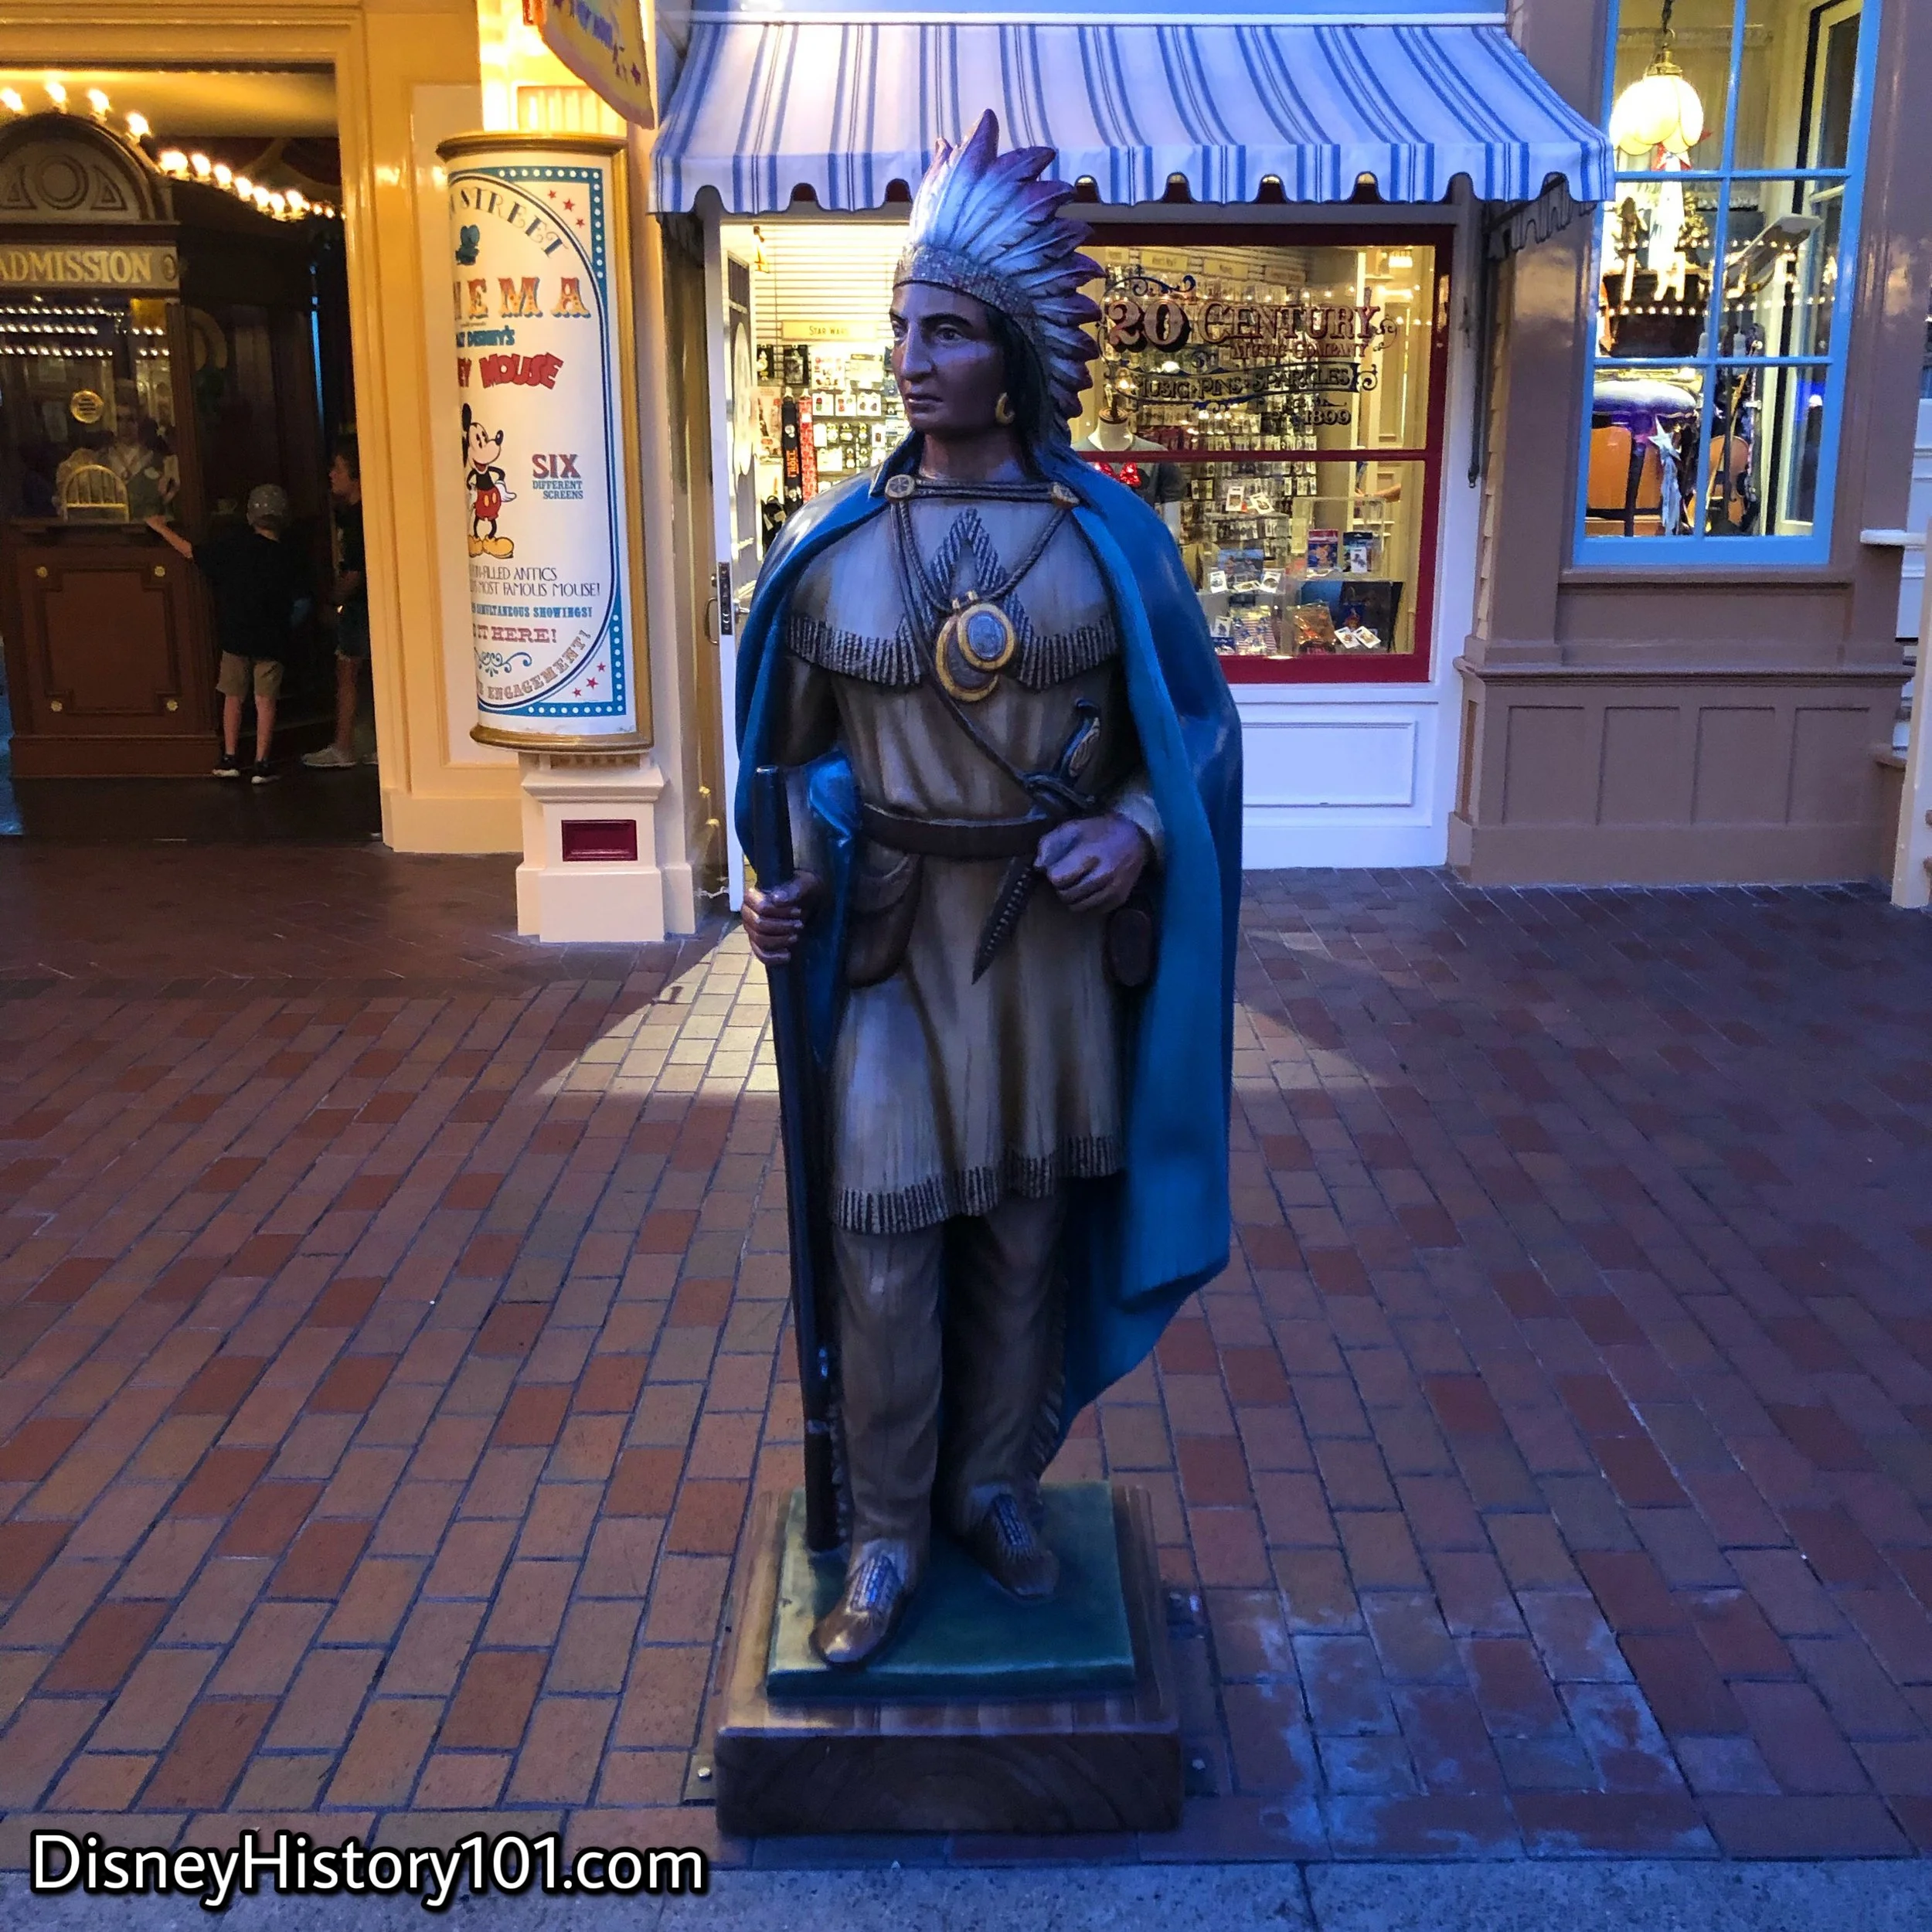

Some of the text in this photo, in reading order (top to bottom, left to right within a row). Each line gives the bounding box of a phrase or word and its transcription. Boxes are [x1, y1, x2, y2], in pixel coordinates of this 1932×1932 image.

[460, 186, 569, 258] STREET
[1107, 286, 1380, 352] 20 CENTURY
[809, 325, 826, 336] STAR
[1291, 340, 1369, 359] COMPANY
[478, 352, 564, 389] MOUSE
[1304, 409, 1352, 426] 1899
[532, 454, 581, 479] SIX
[532, 480, 583, 489] DIFFERENT
[543, 490, 583, 499] SCREENS
[513, 566, 557, 581] ANTICS
[503, 582, 547, 597] FAMOUS
[552, 583, 600, 597] MOUSE!
[477, 603, 530, 618] SIMULTANEOUS
[533, 606, 593, 618] SHOWINGS!
[492, 625, 557, 643] HERE!
[488, 629, 591, 700] ENGAGEMENT!
